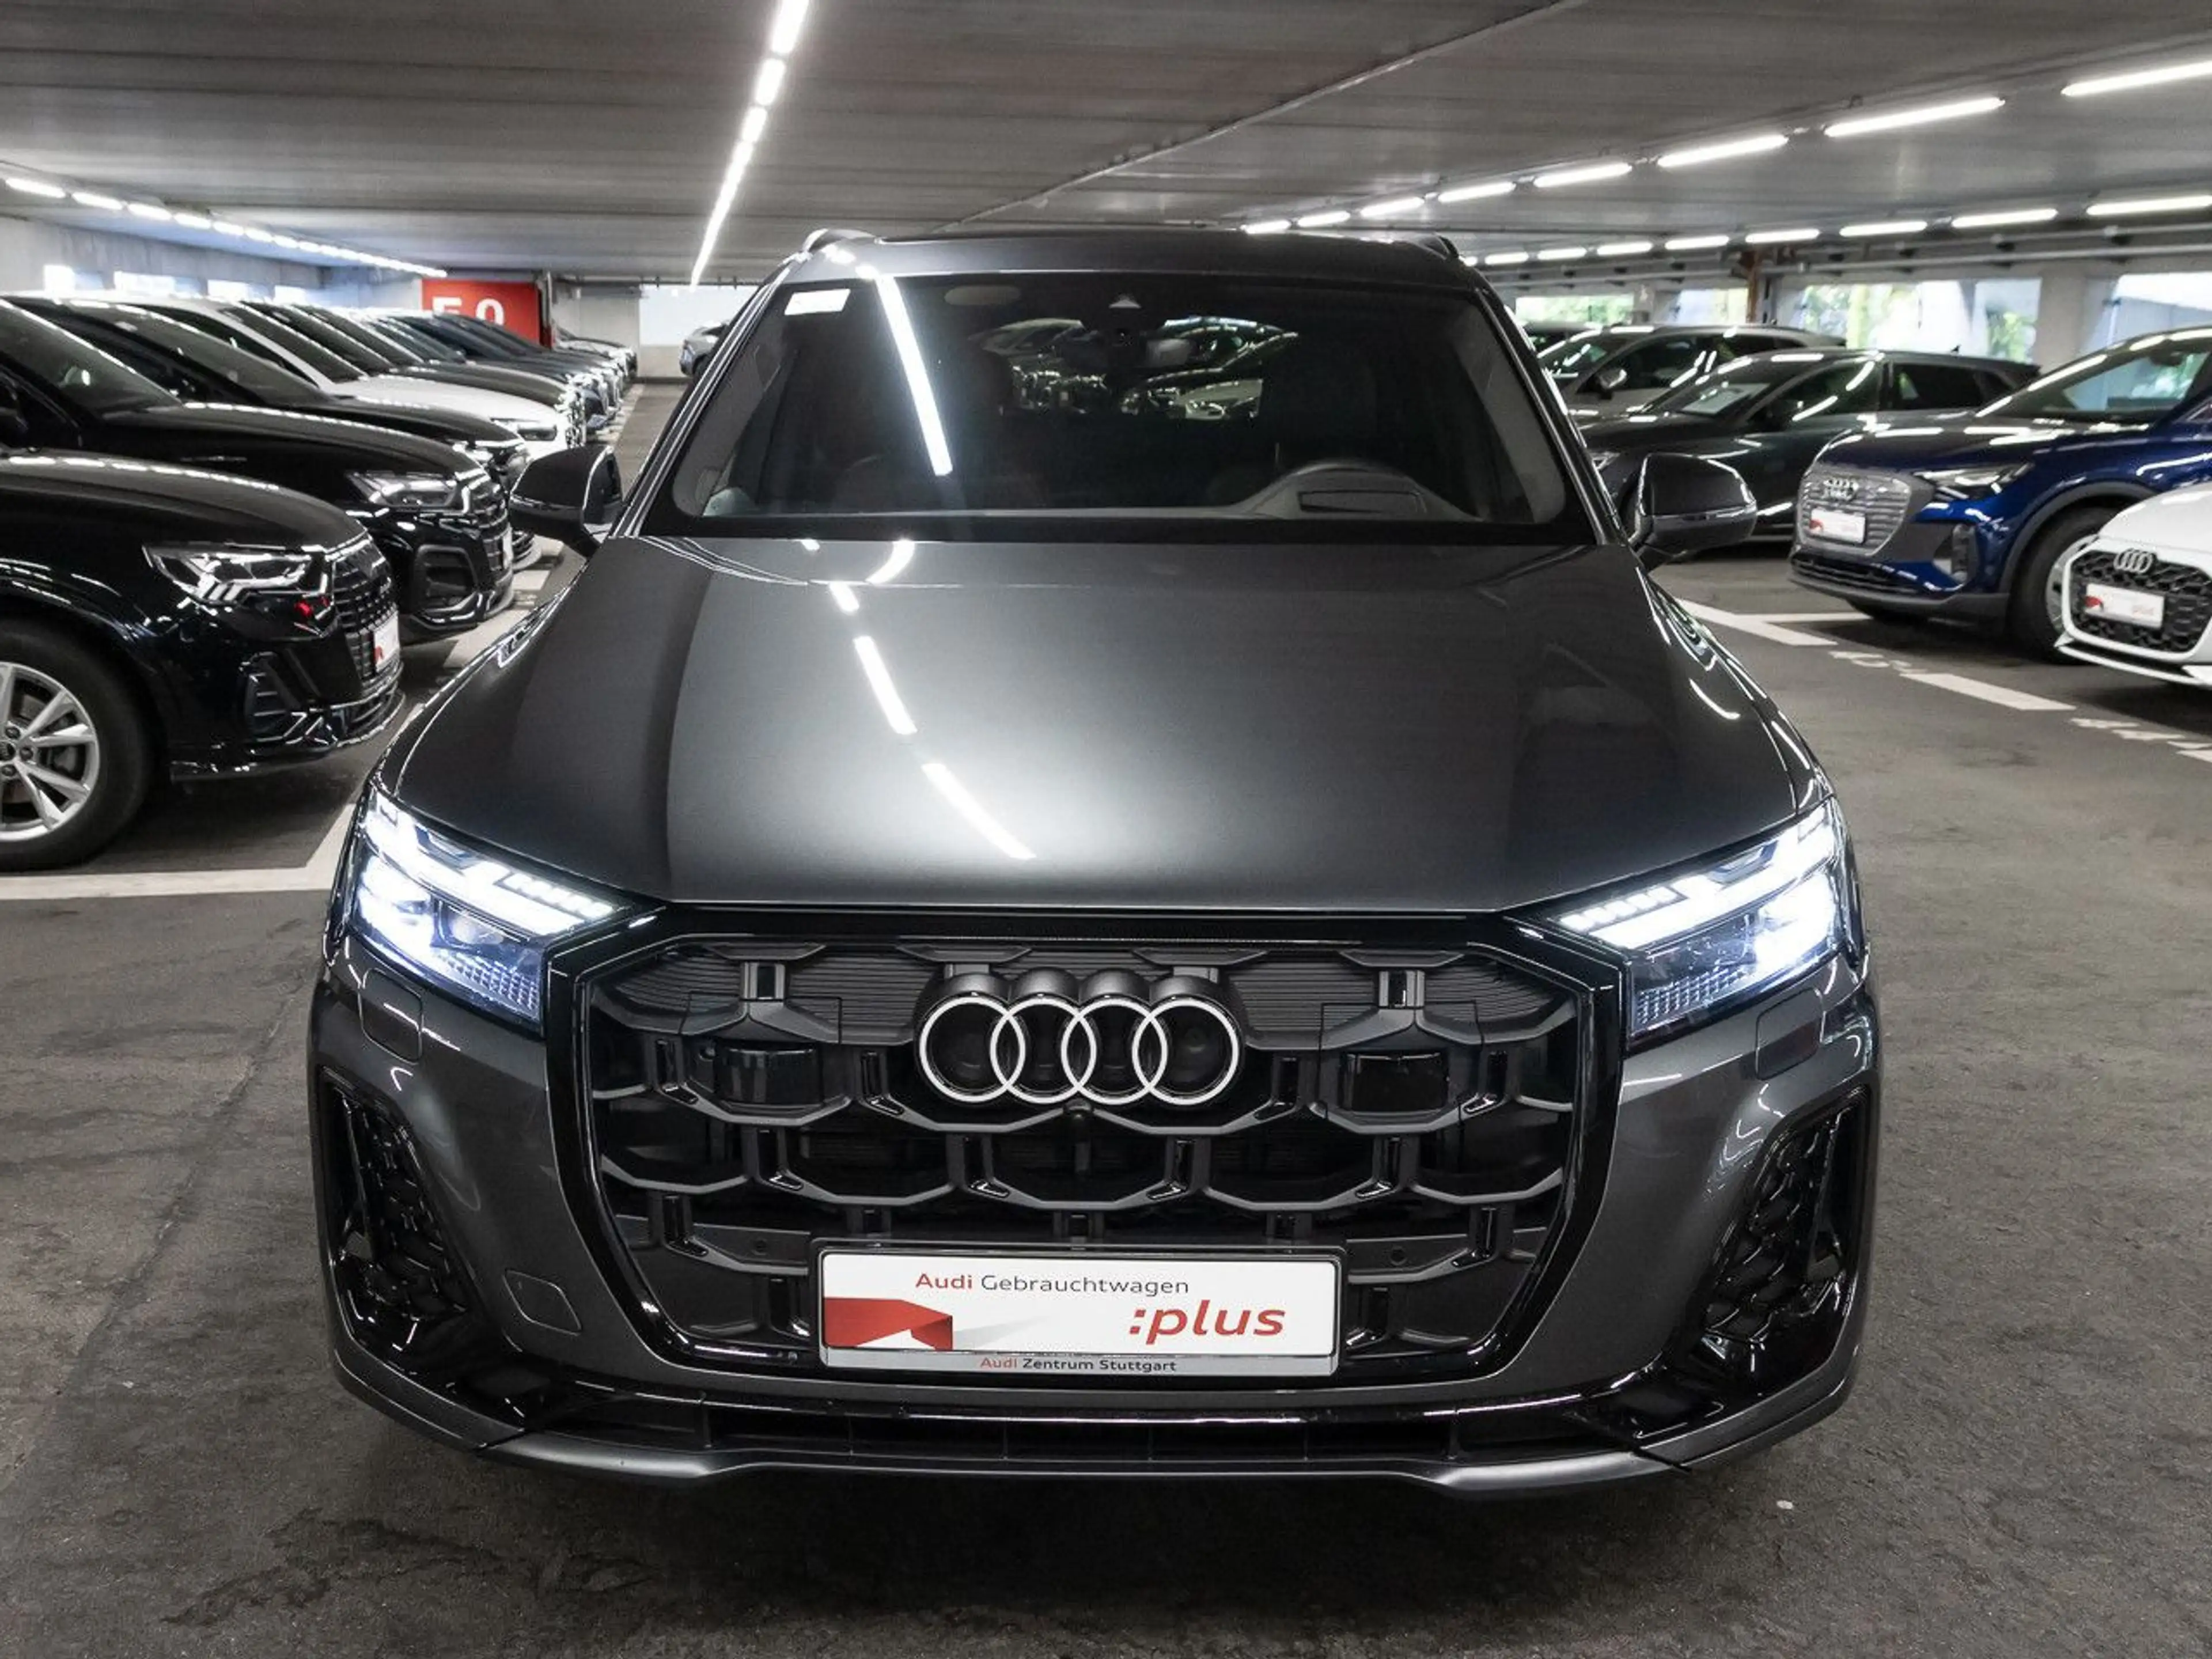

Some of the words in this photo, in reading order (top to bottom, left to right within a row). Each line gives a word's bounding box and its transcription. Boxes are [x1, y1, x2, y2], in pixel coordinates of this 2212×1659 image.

[915, 1272, 973, 1290] Audi
[981, 1275, 1190, 1297] Gebrauchtwagen
[1128, 1300, 1286, 1344] :plus
[980, 1357, 1018, 1369] Audi
[1022, 1358, 1094, 1370] Zentrum
[1099, 1359, 1177, 1373] Stuttgart
